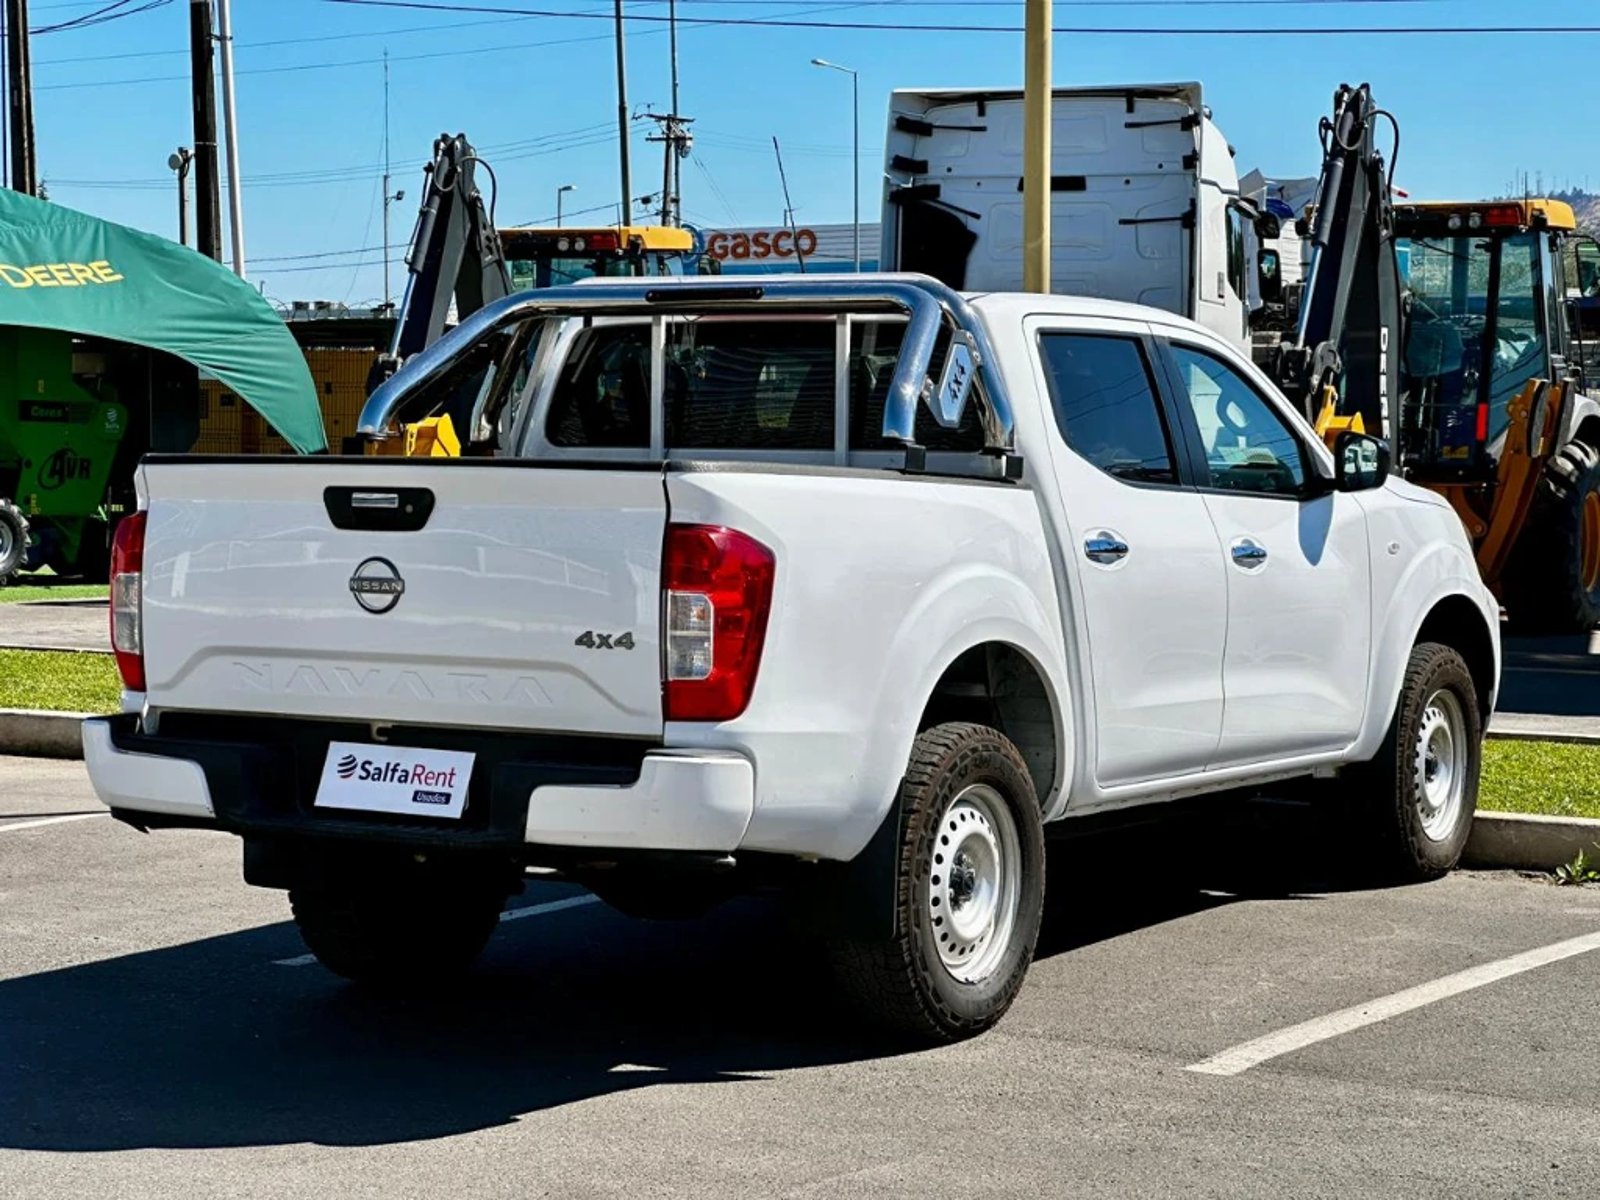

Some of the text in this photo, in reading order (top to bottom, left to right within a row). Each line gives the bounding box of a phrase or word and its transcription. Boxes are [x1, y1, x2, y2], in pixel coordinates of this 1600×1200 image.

[0, 261, 124, 287] DEERE
[48, 451, 91, 480] AVR
[350, 579, 403, 592] NISSAN
[574, 631, 635, 650] 4x4
[232, 662, 553, 705] NAVARA
[358, 760, 456, 788] SalfaRent
